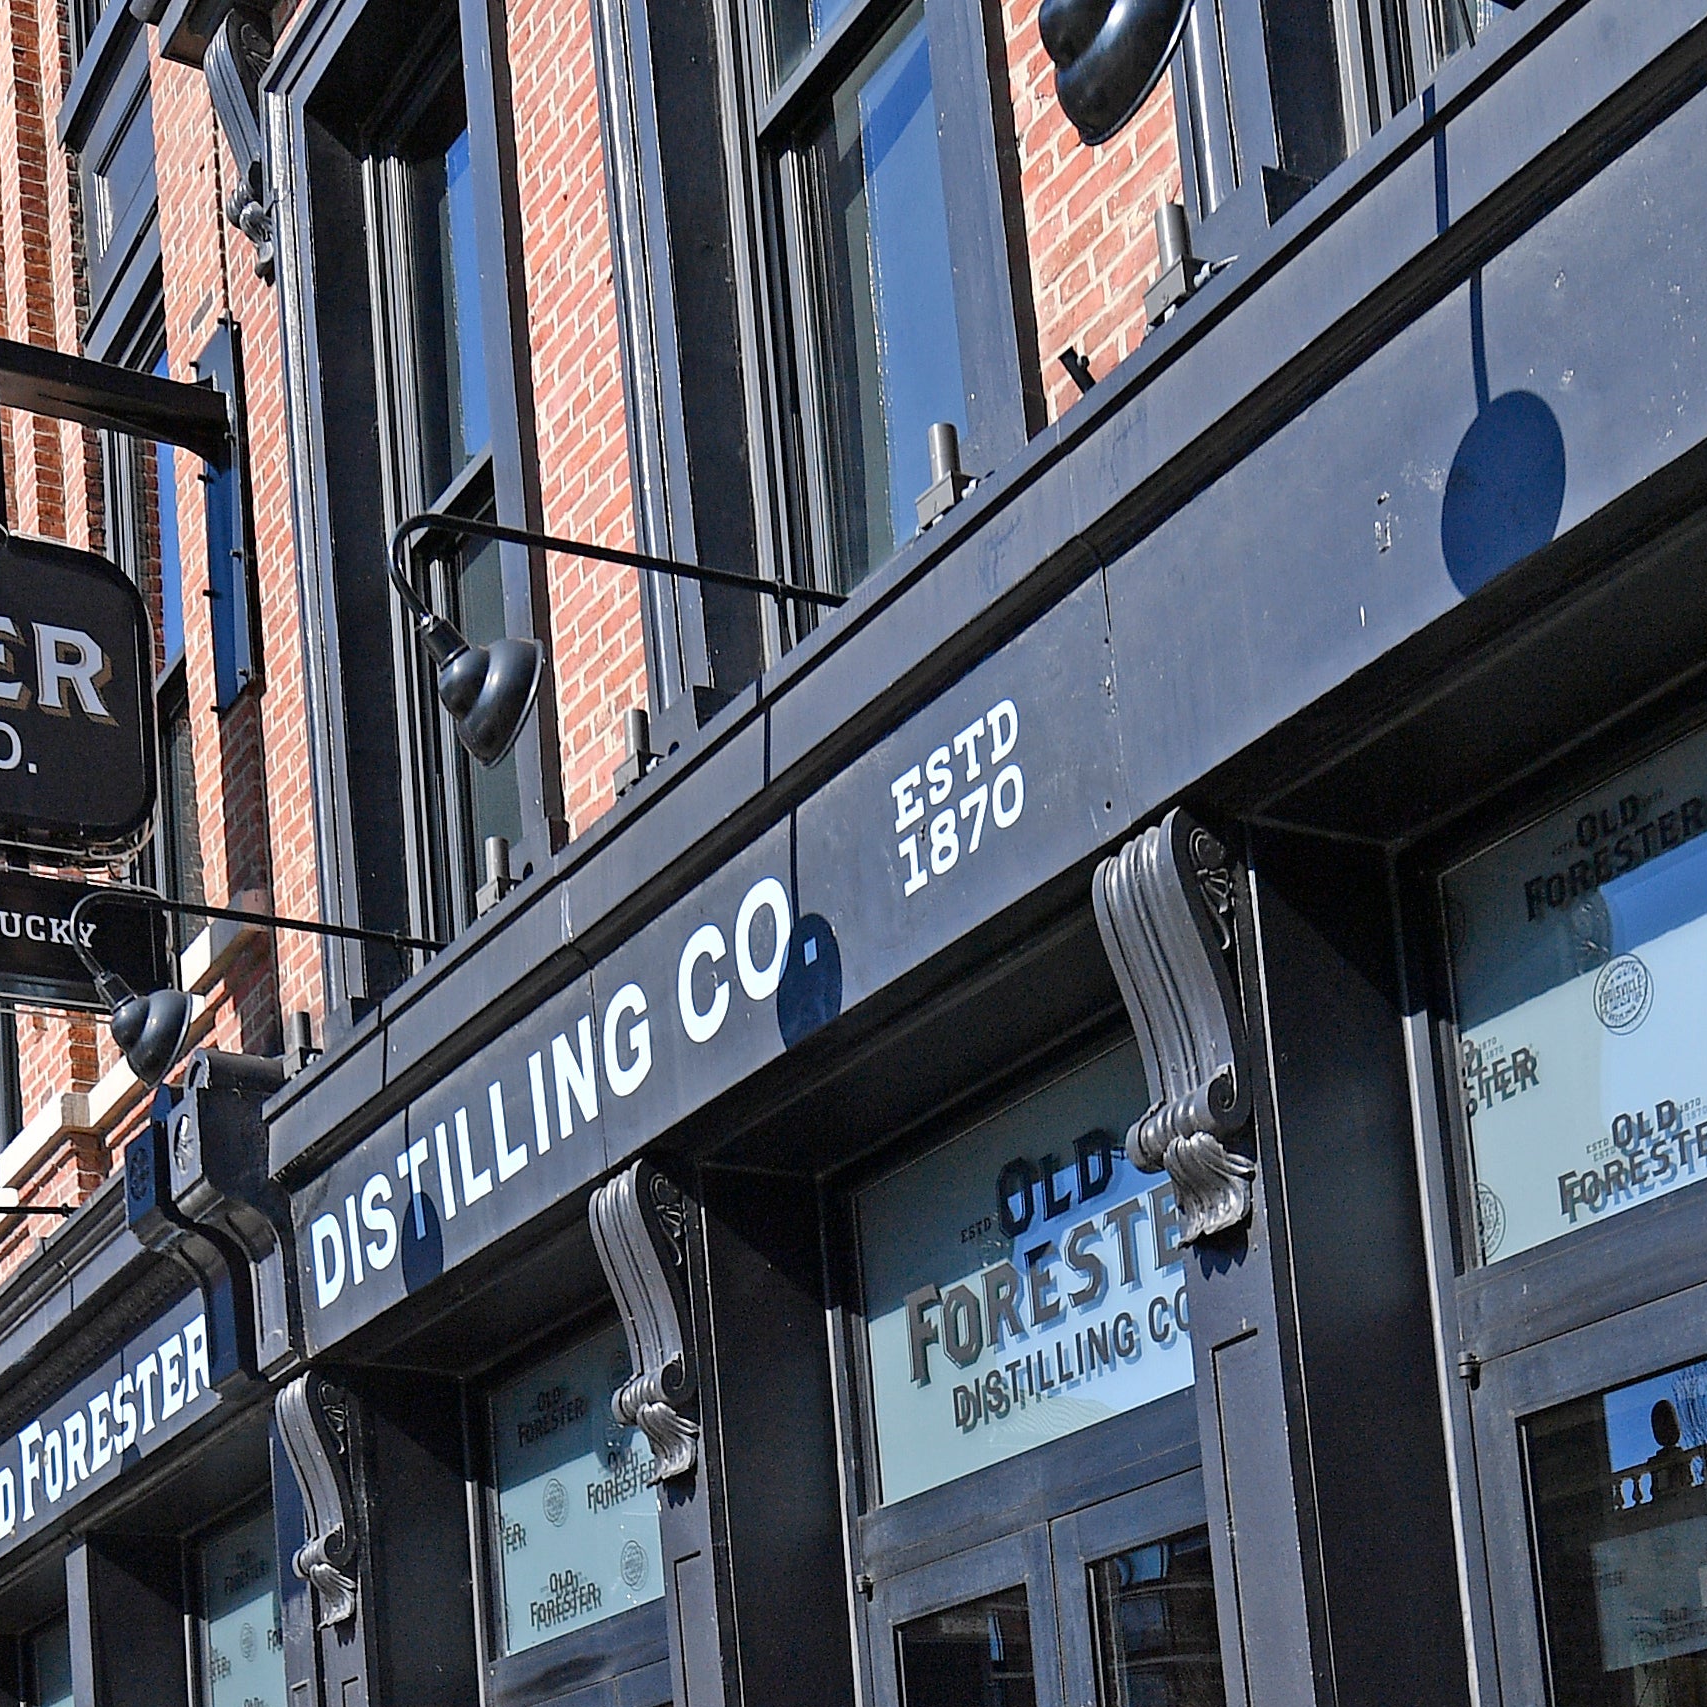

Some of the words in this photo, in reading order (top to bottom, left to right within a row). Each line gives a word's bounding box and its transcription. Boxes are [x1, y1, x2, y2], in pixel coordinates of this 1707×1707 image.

[890, 698, 1019, 833] ESTD
[1576, 794, 1641, 847] OLD
[897, 763, 1026, 897] 1870
[1524, 797, 1706, 922] FORESTER
[311, 982, 653, 1309] DISTILLING
[998, 1128, 1115, 1240] OLD
[1611, 1099, 1677, 1149] OLD
[903, 1181, 1185, 1389] FORESTE
[17, 1313, 211, 1523] FORESTER
[952, 1311, 1141, 1434] DISTILLING
[530, 1582, 599, 1629] FORESTER
